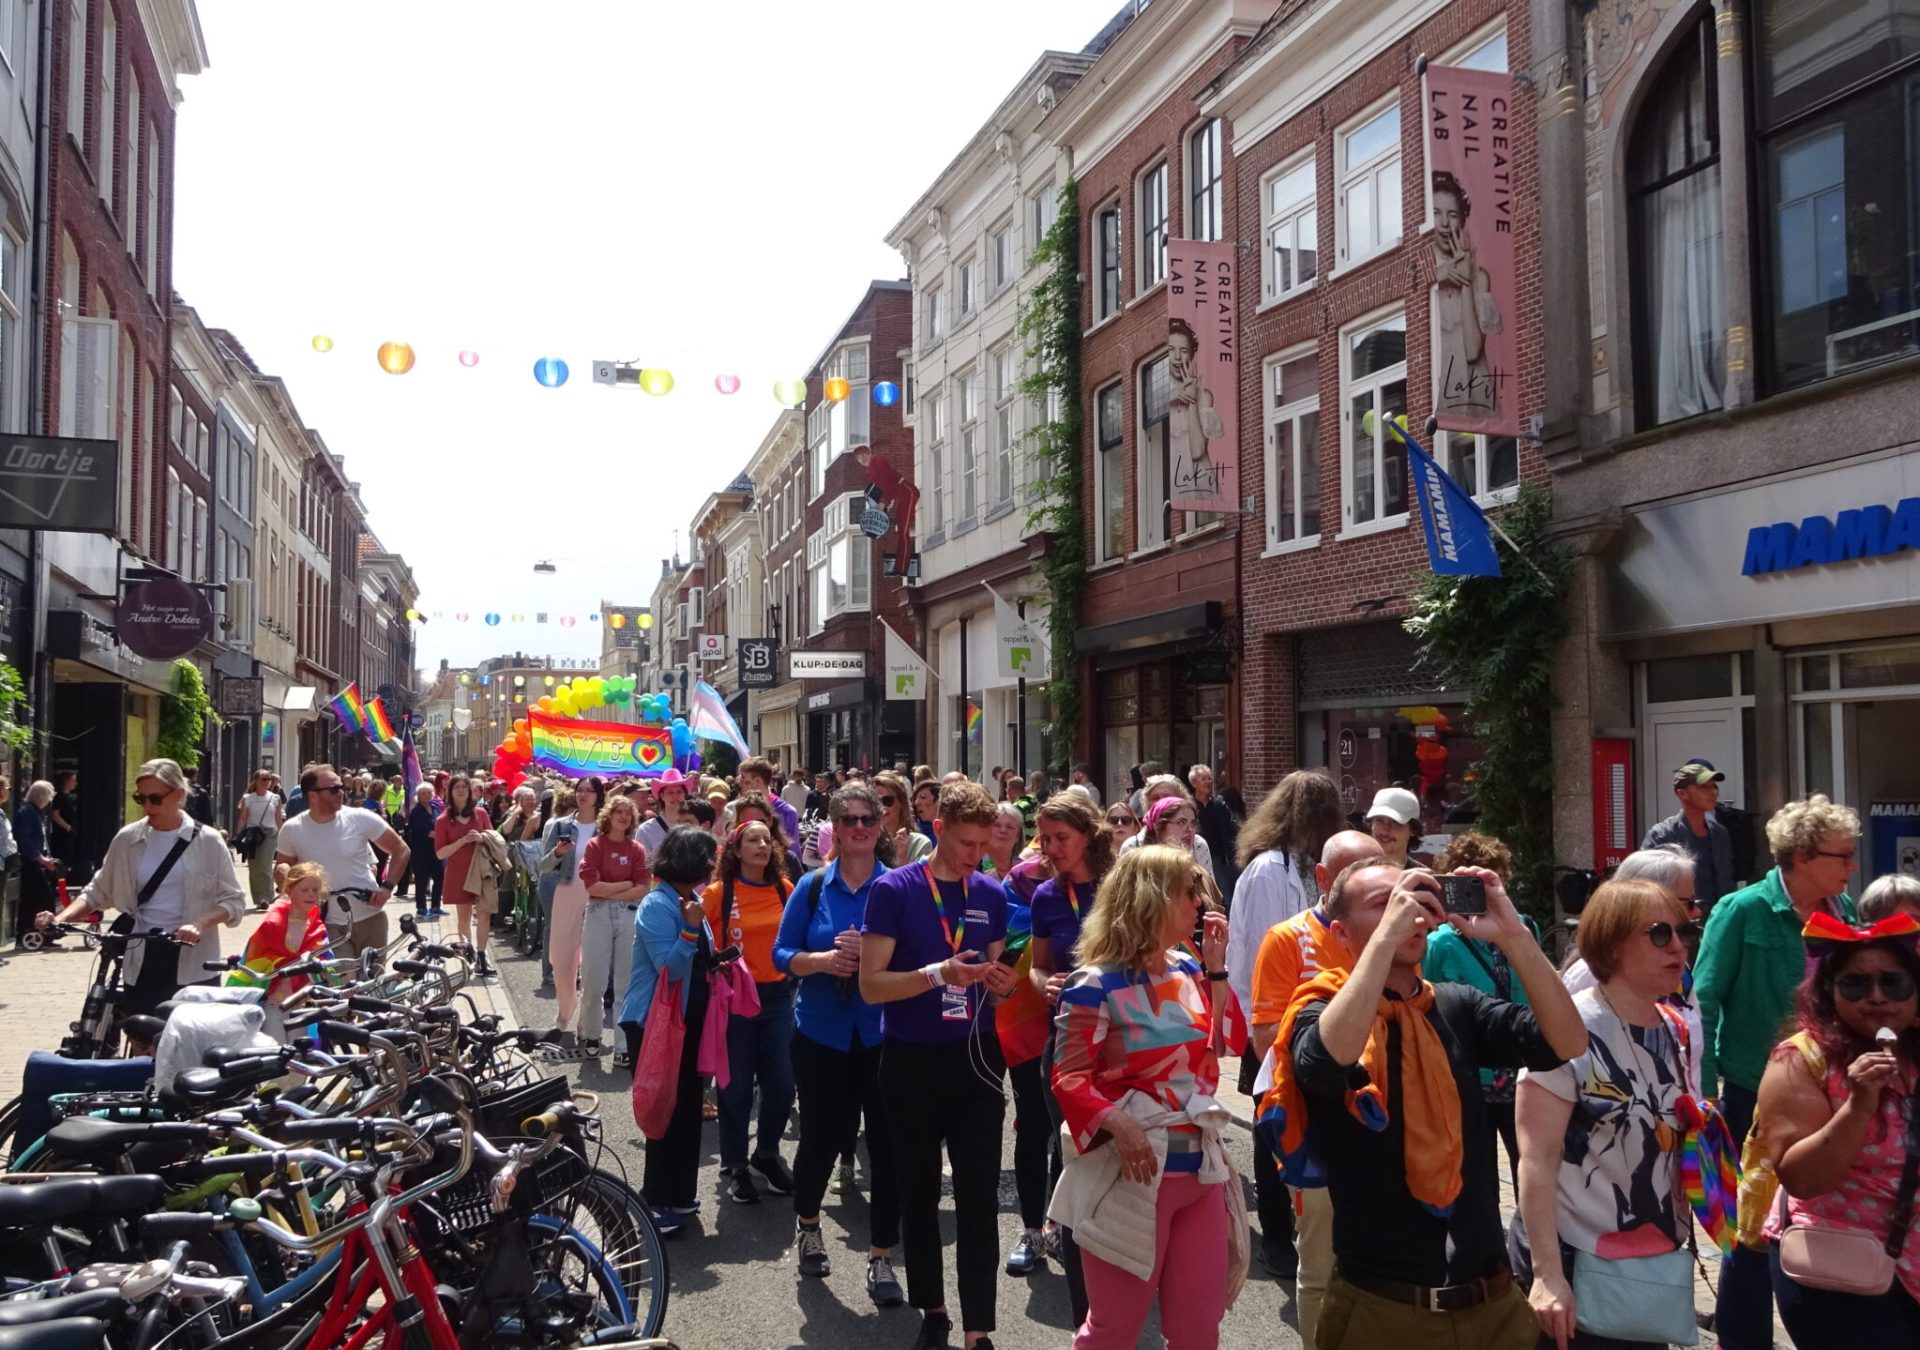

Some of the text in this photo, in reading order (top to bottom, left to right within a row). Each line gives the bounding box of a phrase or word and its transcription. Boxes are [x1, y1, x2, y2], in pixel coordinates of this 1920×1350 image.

[1431, 90, 1449, 141] LAB
[1461, 93, 1480, 159] NAIL
[1491, 97, 1511, 233] CREATIVE
[1170, 258, 1184, 295] LAB
[1194, 260, 1208, 309] NAIL
[1217, 261, 1232, 362] CREATIVE
[600, 368, 609, 377] G
[543, 729, 625, 769] LOVE
[1341, 740, 1353, 755] 21
